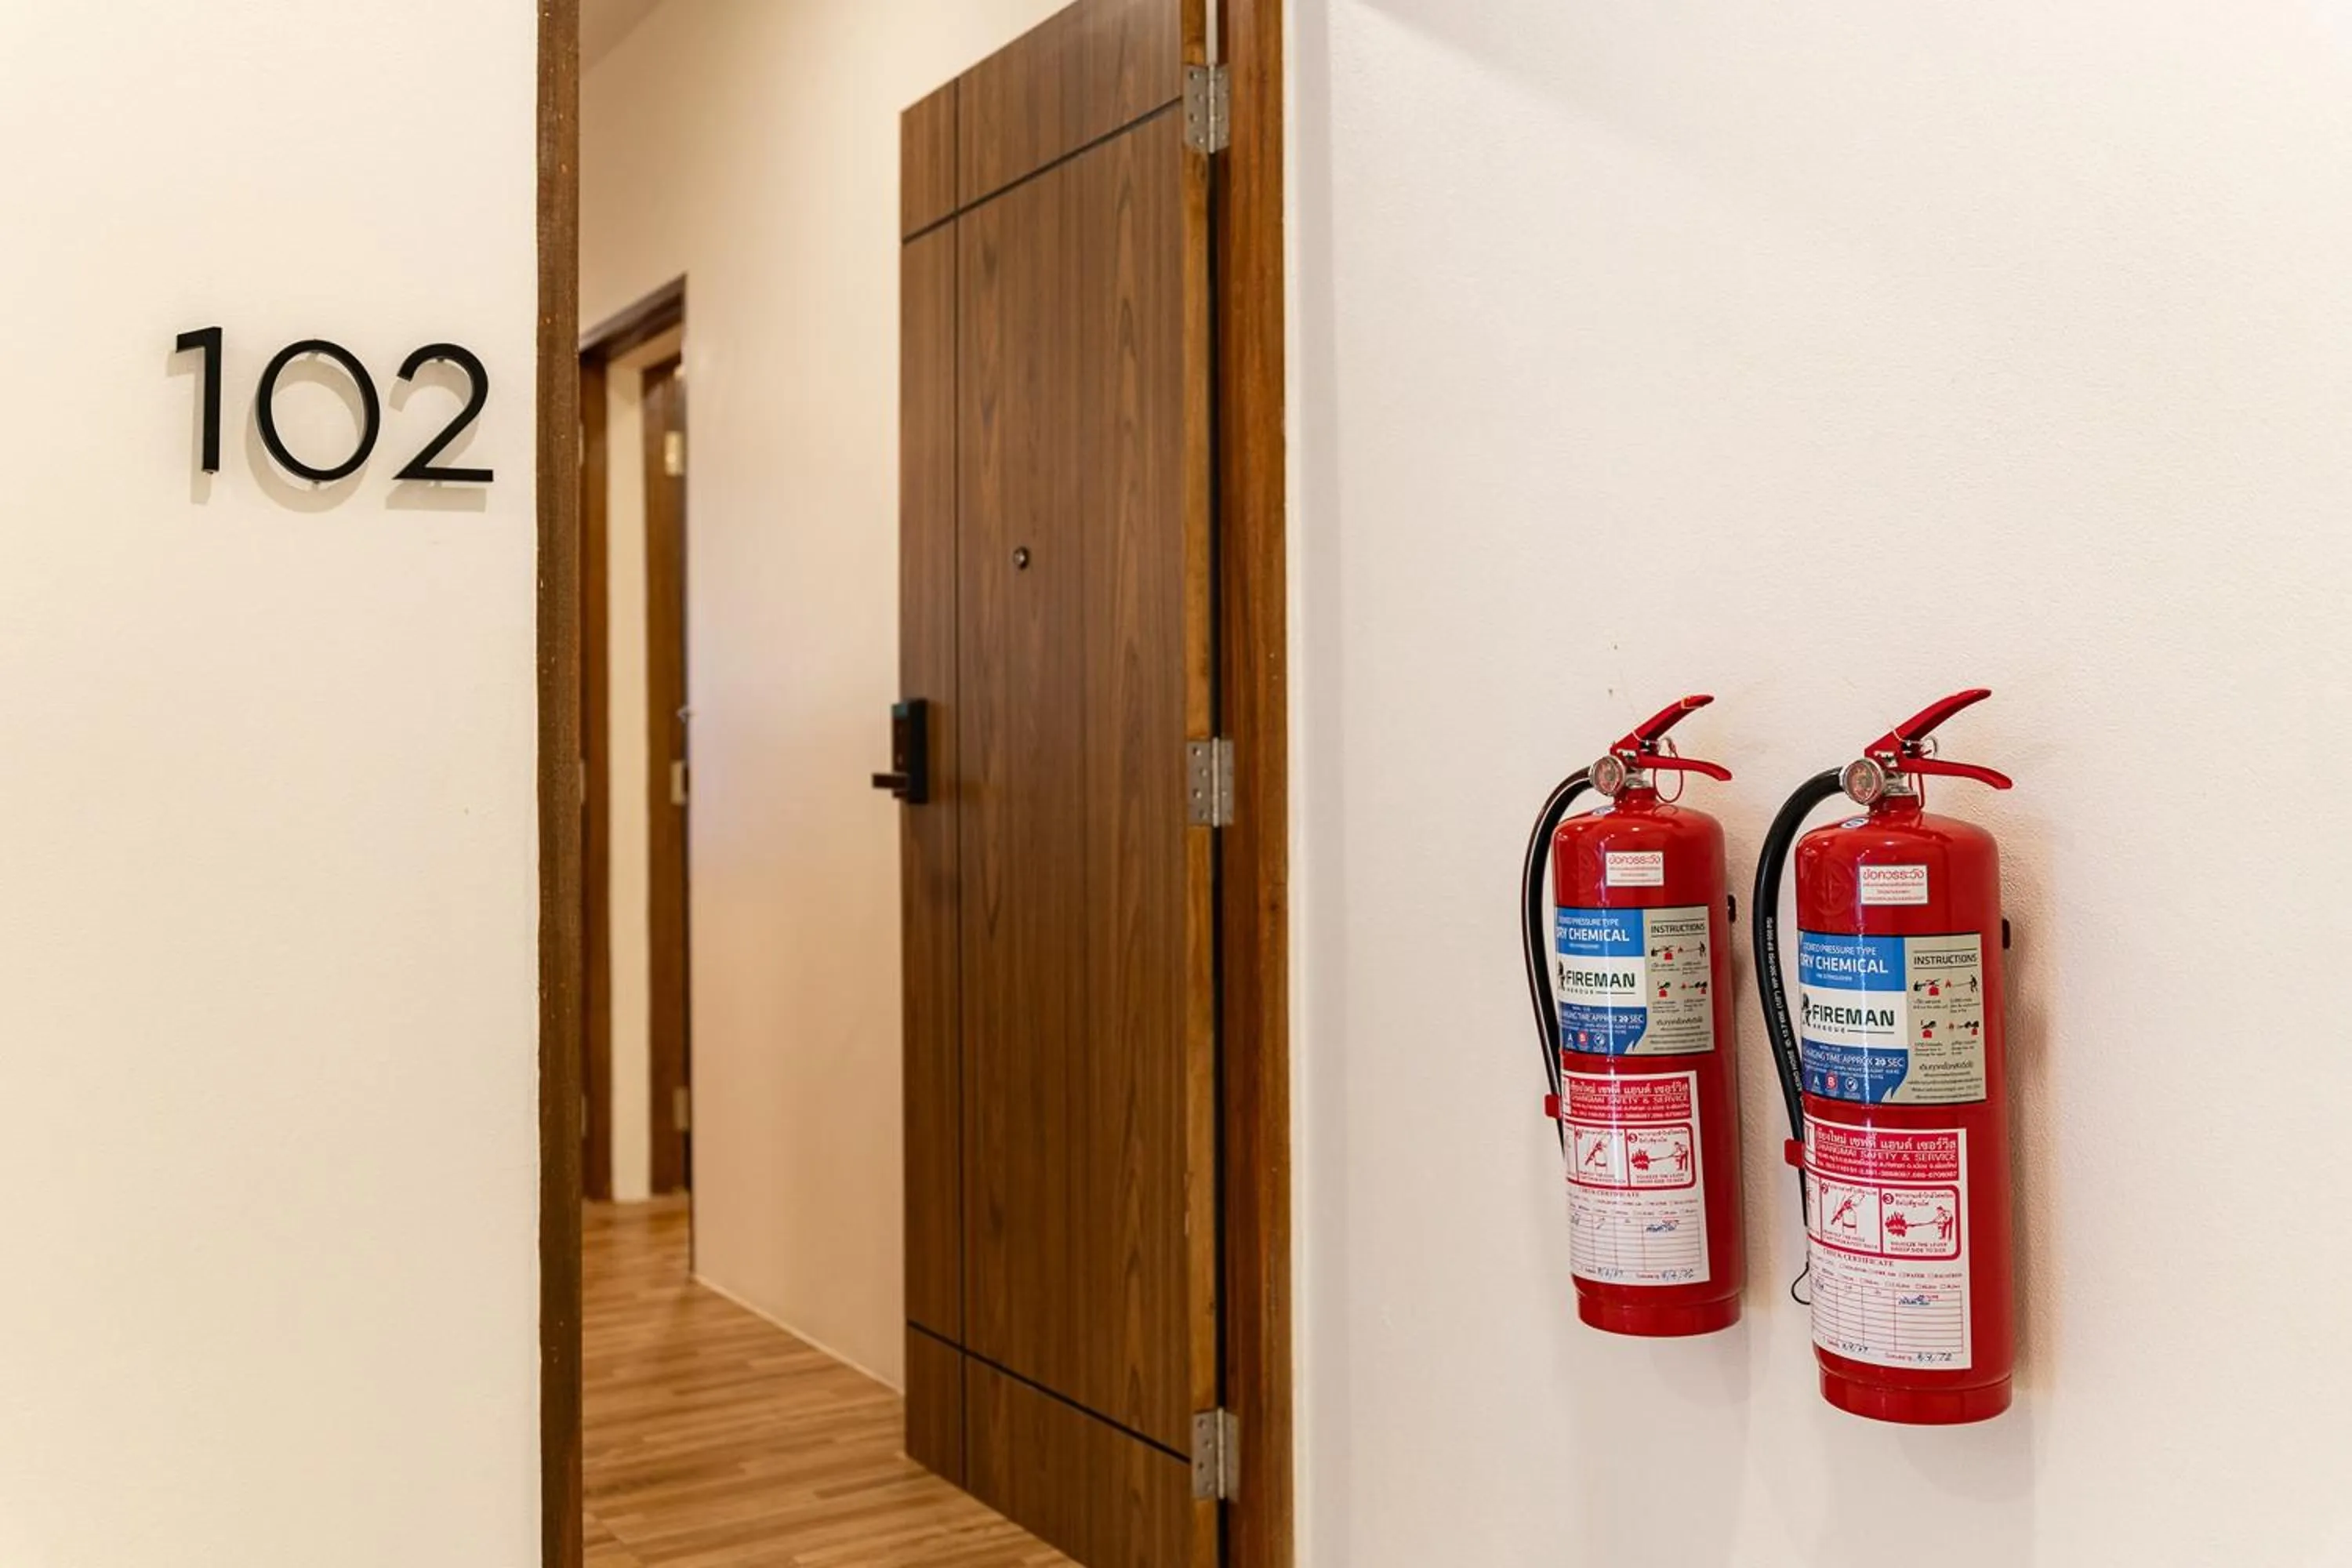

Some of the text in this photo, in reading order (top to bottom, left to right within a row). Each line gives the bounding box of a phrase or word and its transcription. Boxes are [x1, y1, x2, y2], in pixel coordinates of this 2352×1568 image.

[176, 326, 494, 482] 102
[1569, 927, 1630, 942] CHEMICAL
[1857, 946, 1877, 956] TYPE
[1914, 953, 1977, 965] INSTRUCTIONS
[1815, 956, 1889, 973] CHEMICAL
[1566, 971, 1635, 988] FIREMAN
[1813, 1004, 1894, 1026] FIREMAN
[1875, 1057, 1886, 1066] 20
[1888, 1056, 1905, 1067] SEC
